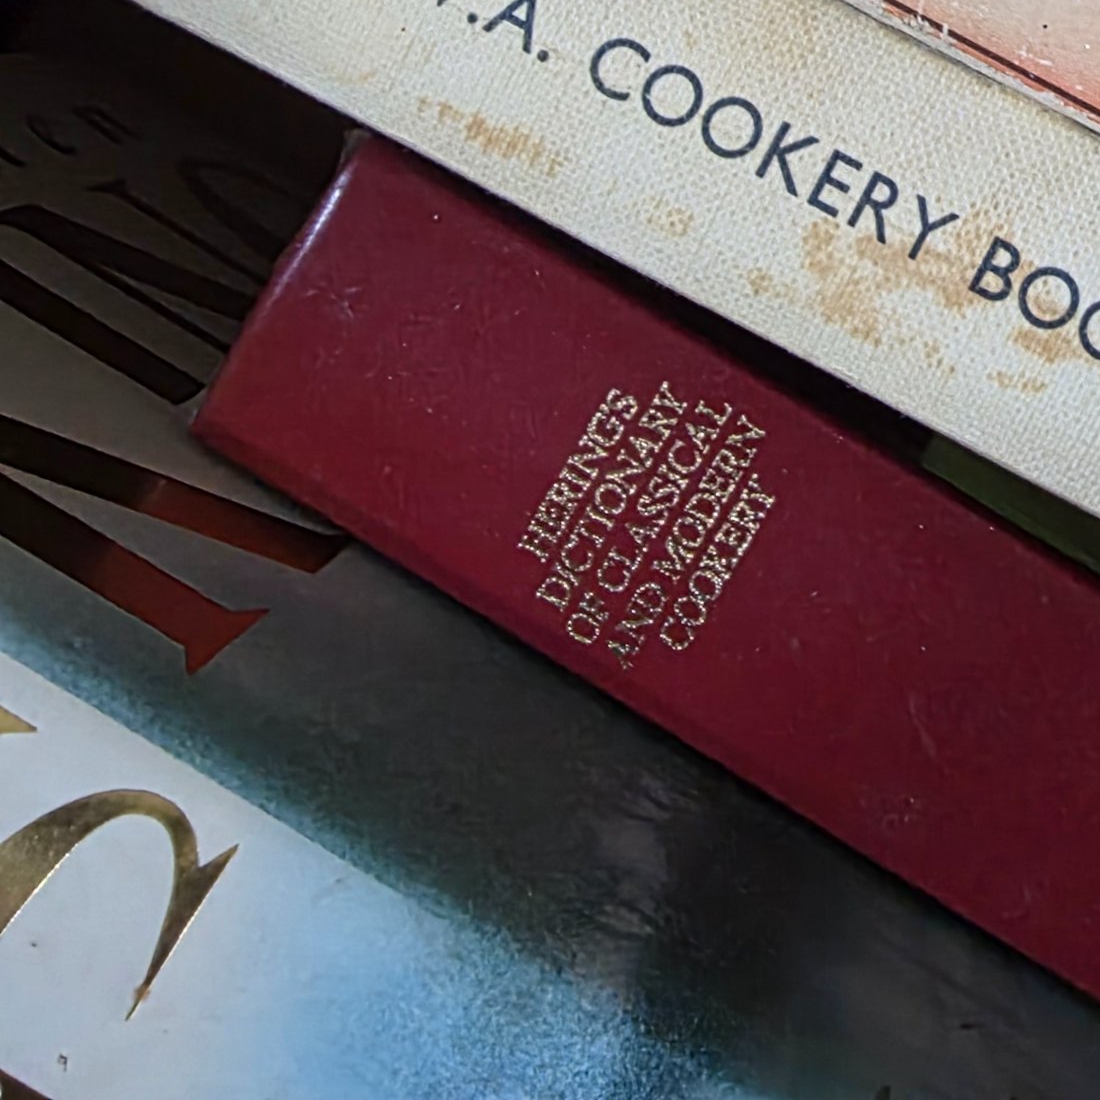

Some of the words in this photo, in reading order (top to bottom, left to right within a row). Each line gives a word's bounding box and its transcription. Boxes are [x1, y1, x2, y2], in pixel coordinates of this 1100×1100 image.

[590, 38, 960, 261] COOKERY
[535, 380, 688, 613] DICTIONARY
[566, 591, 610, 645] OF
[596, 399, 733, 593] CLASSICAL
[607, 581, 666, 671] AND
[652, 413, 767, 585] MODERN
[659, 472, 776, 651] COOKERY
